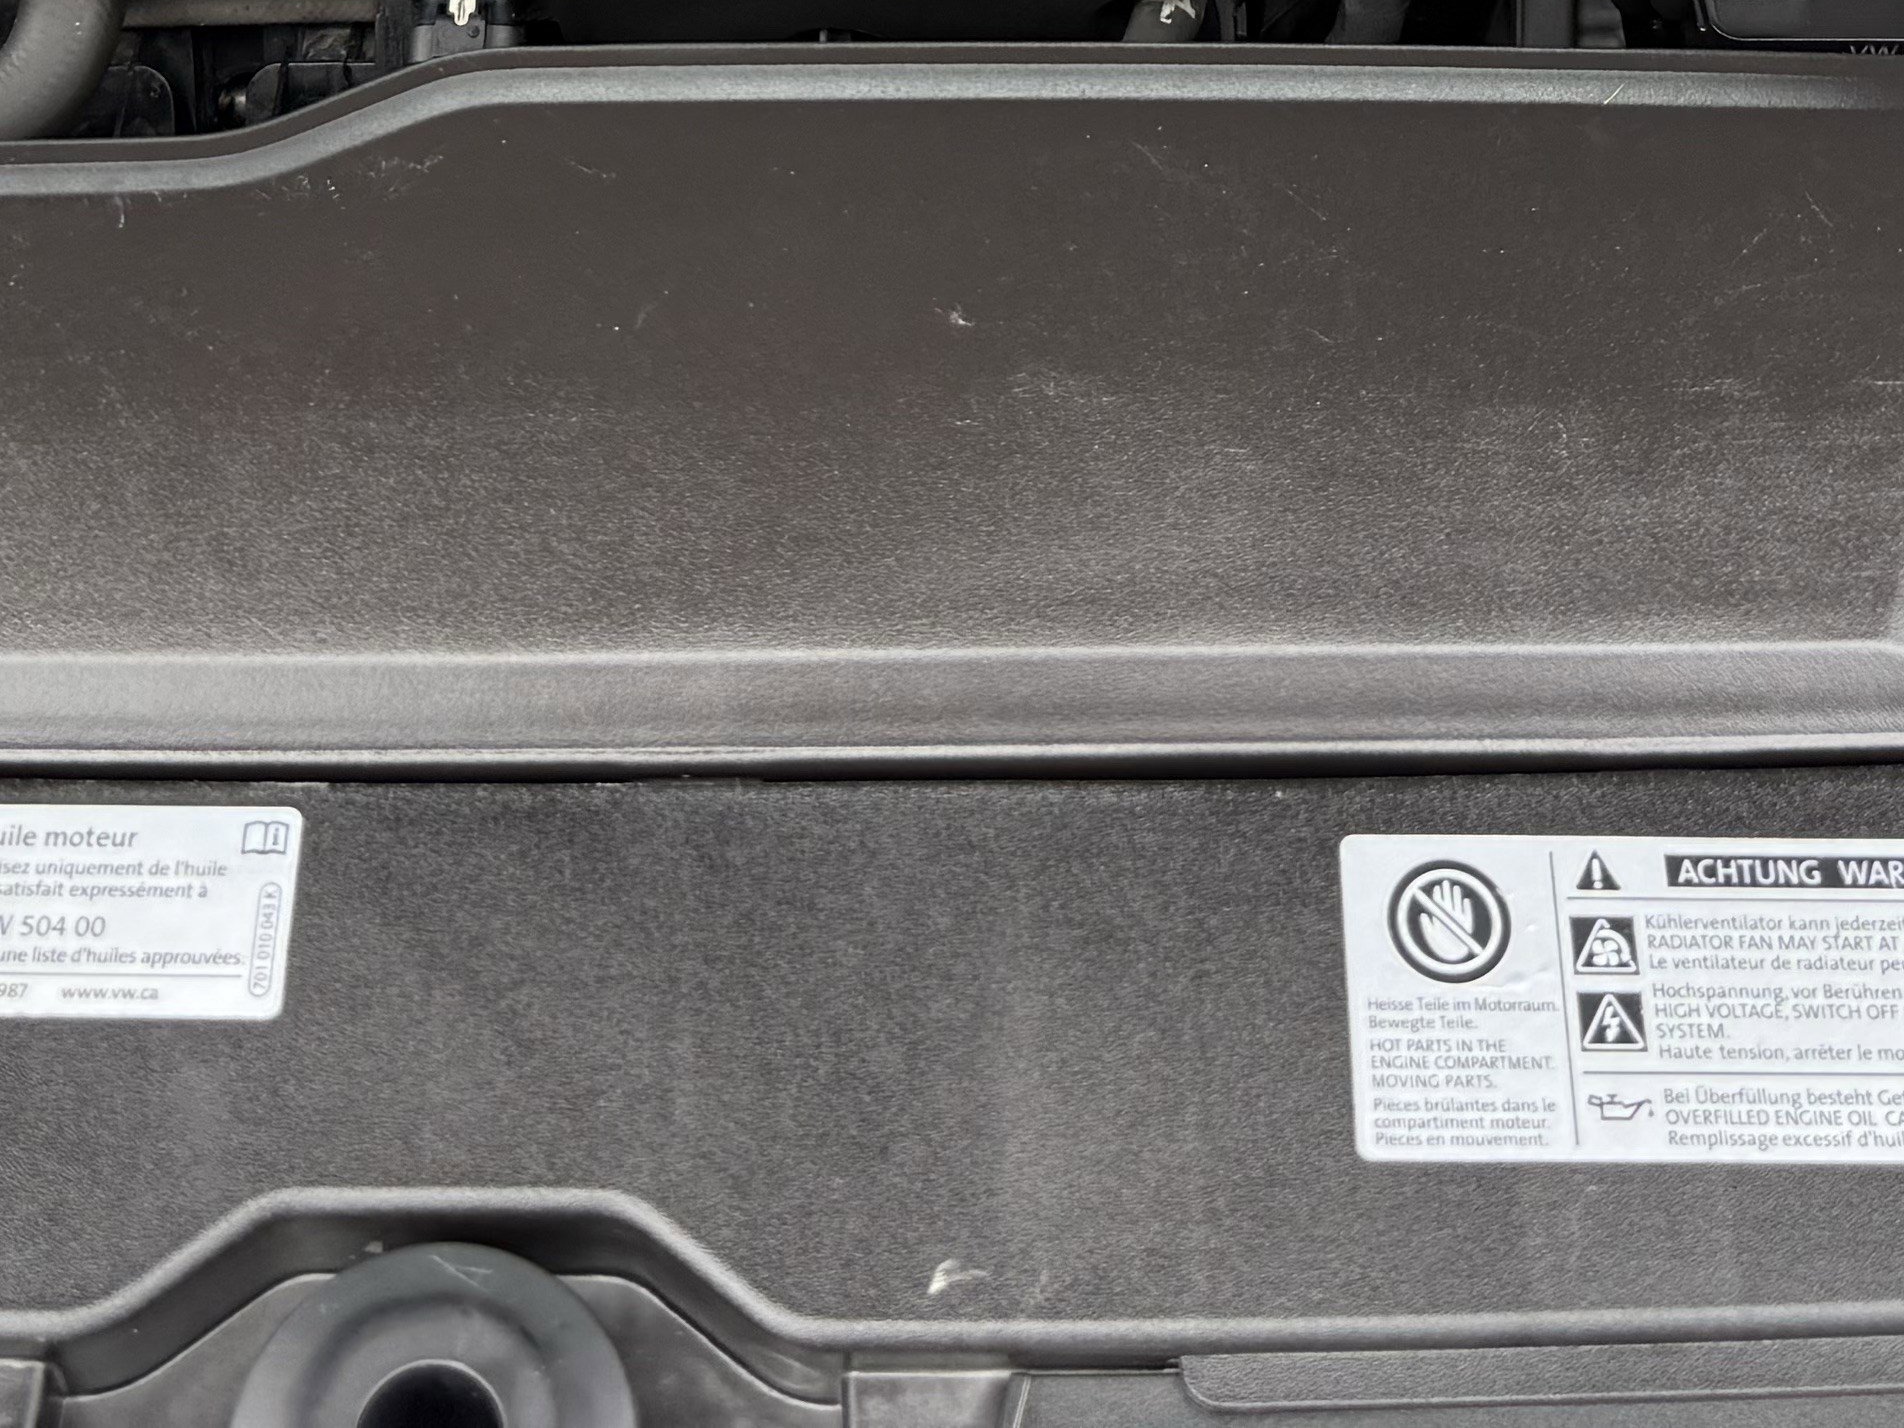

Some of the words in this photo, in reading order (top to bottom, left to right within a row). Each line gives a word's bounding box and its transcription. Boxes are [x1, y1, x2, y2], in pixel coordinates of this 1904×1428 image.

[45, 826, 139, 849] moteur
[35, 860, 143, 880] uniquement
[175, 861, 228, 877] l'huile
[1677, 859, 1822, 886] ACHTUNG
[68, 882, 188, 901] expressément
[19, 915, 66, 937] 504
[1645, 914, 1783, 932] Kühlerventilator
[1789, 915, 1830, 932] kann
[1647, 934, 1734, 950] RADIATOR
[1738, 935, 1774, 950] FAN
[1778, 935, 1816, 950] MAY
[32, 947, 67, 964] liste
[71, 947, 137, 965] d'huiles
[1672, 955, 1765, 971] ventilateur
[1797, 956, 1874, 972] radiateur
[62, 985, 159, 1001] www.vw.ca
[1823, 983, 1903, 1000] Berühren
[1368, 998, 1413, 1012] Heisse
[1417, 998, 1450, 1012] Teile
[1475, 999, 1560, 1013] Motorraum.
[1654, 1003, 1702, 1019] HIGH
[1793, 1004, 1862, 1020] SWITCH
[1866, 1004, 1900, 1020] OFF
[1369, 1016, 1436, 1033] Bewegte
[1656, 1023, 1731, 1039] SYSTEM.
[1370, 1039, 1403, 1053] HOT
[1406, 1039, 1453, 1053] PARTS
[1477, 1039, 1507, 1053] THE
[1659, 1044, 1713, 1060] Haute
[1793, 1045, 1854, 1061] arrêter
[1371, 1056, 1429, 1069] ENGINE
[1433, 1056, 1555, 1070] COMPARTMENT.
[1372, 1074, 1440, 1089] MOVING
[1424, 1097, 1497, 1112] brûlantes
[1501, 1098, 1539, 1113] dans
[1696, 1085, 1802, 1110] Überfüllung
[1806, 1088, 1873, 1105] besteht
[1374, 1116, 1486, 1131] compartiment
[1665, 1109, 1770, 1126] OVERFILLED
[1775, 1109, 1843, 1126] ENGINE
[1847, 1110, 1877, 1127] OIL
[1450, 1134, 1549, 1147] mouvement.
[1668, 1129, 1778, 1152] Remplissage
[1782, 1130, 1853, 1148] excessif
